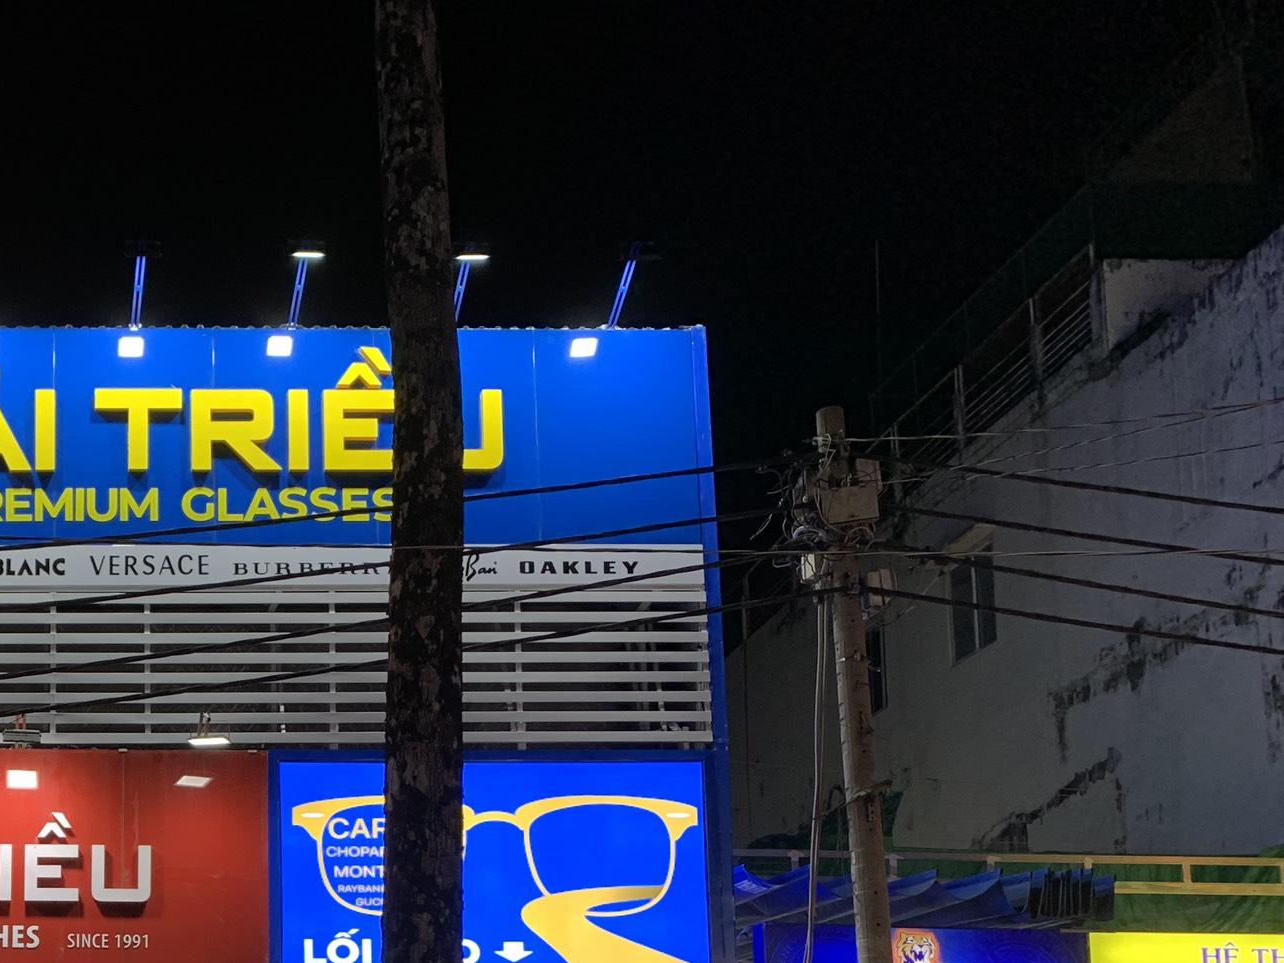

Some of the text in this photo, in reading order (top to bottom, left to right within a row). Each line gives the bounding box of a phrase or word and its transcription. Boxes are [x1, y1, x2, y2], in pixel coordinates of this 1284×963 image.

[181, 486, 394, 523] GLASSES
[89, 554, 210, 577] VERSACE
[233, 561, 391, 576] BURBERR
[519, 560, 639, 575] OAKLEY
[326, 846, 385, 858] CHOPA
[334, 865, 384, 879] MONT
[337, 884, 385, 893] RAYBAN
[67, 932, 109, 949] SINCE
[114, 933, 150, 949] 1991
